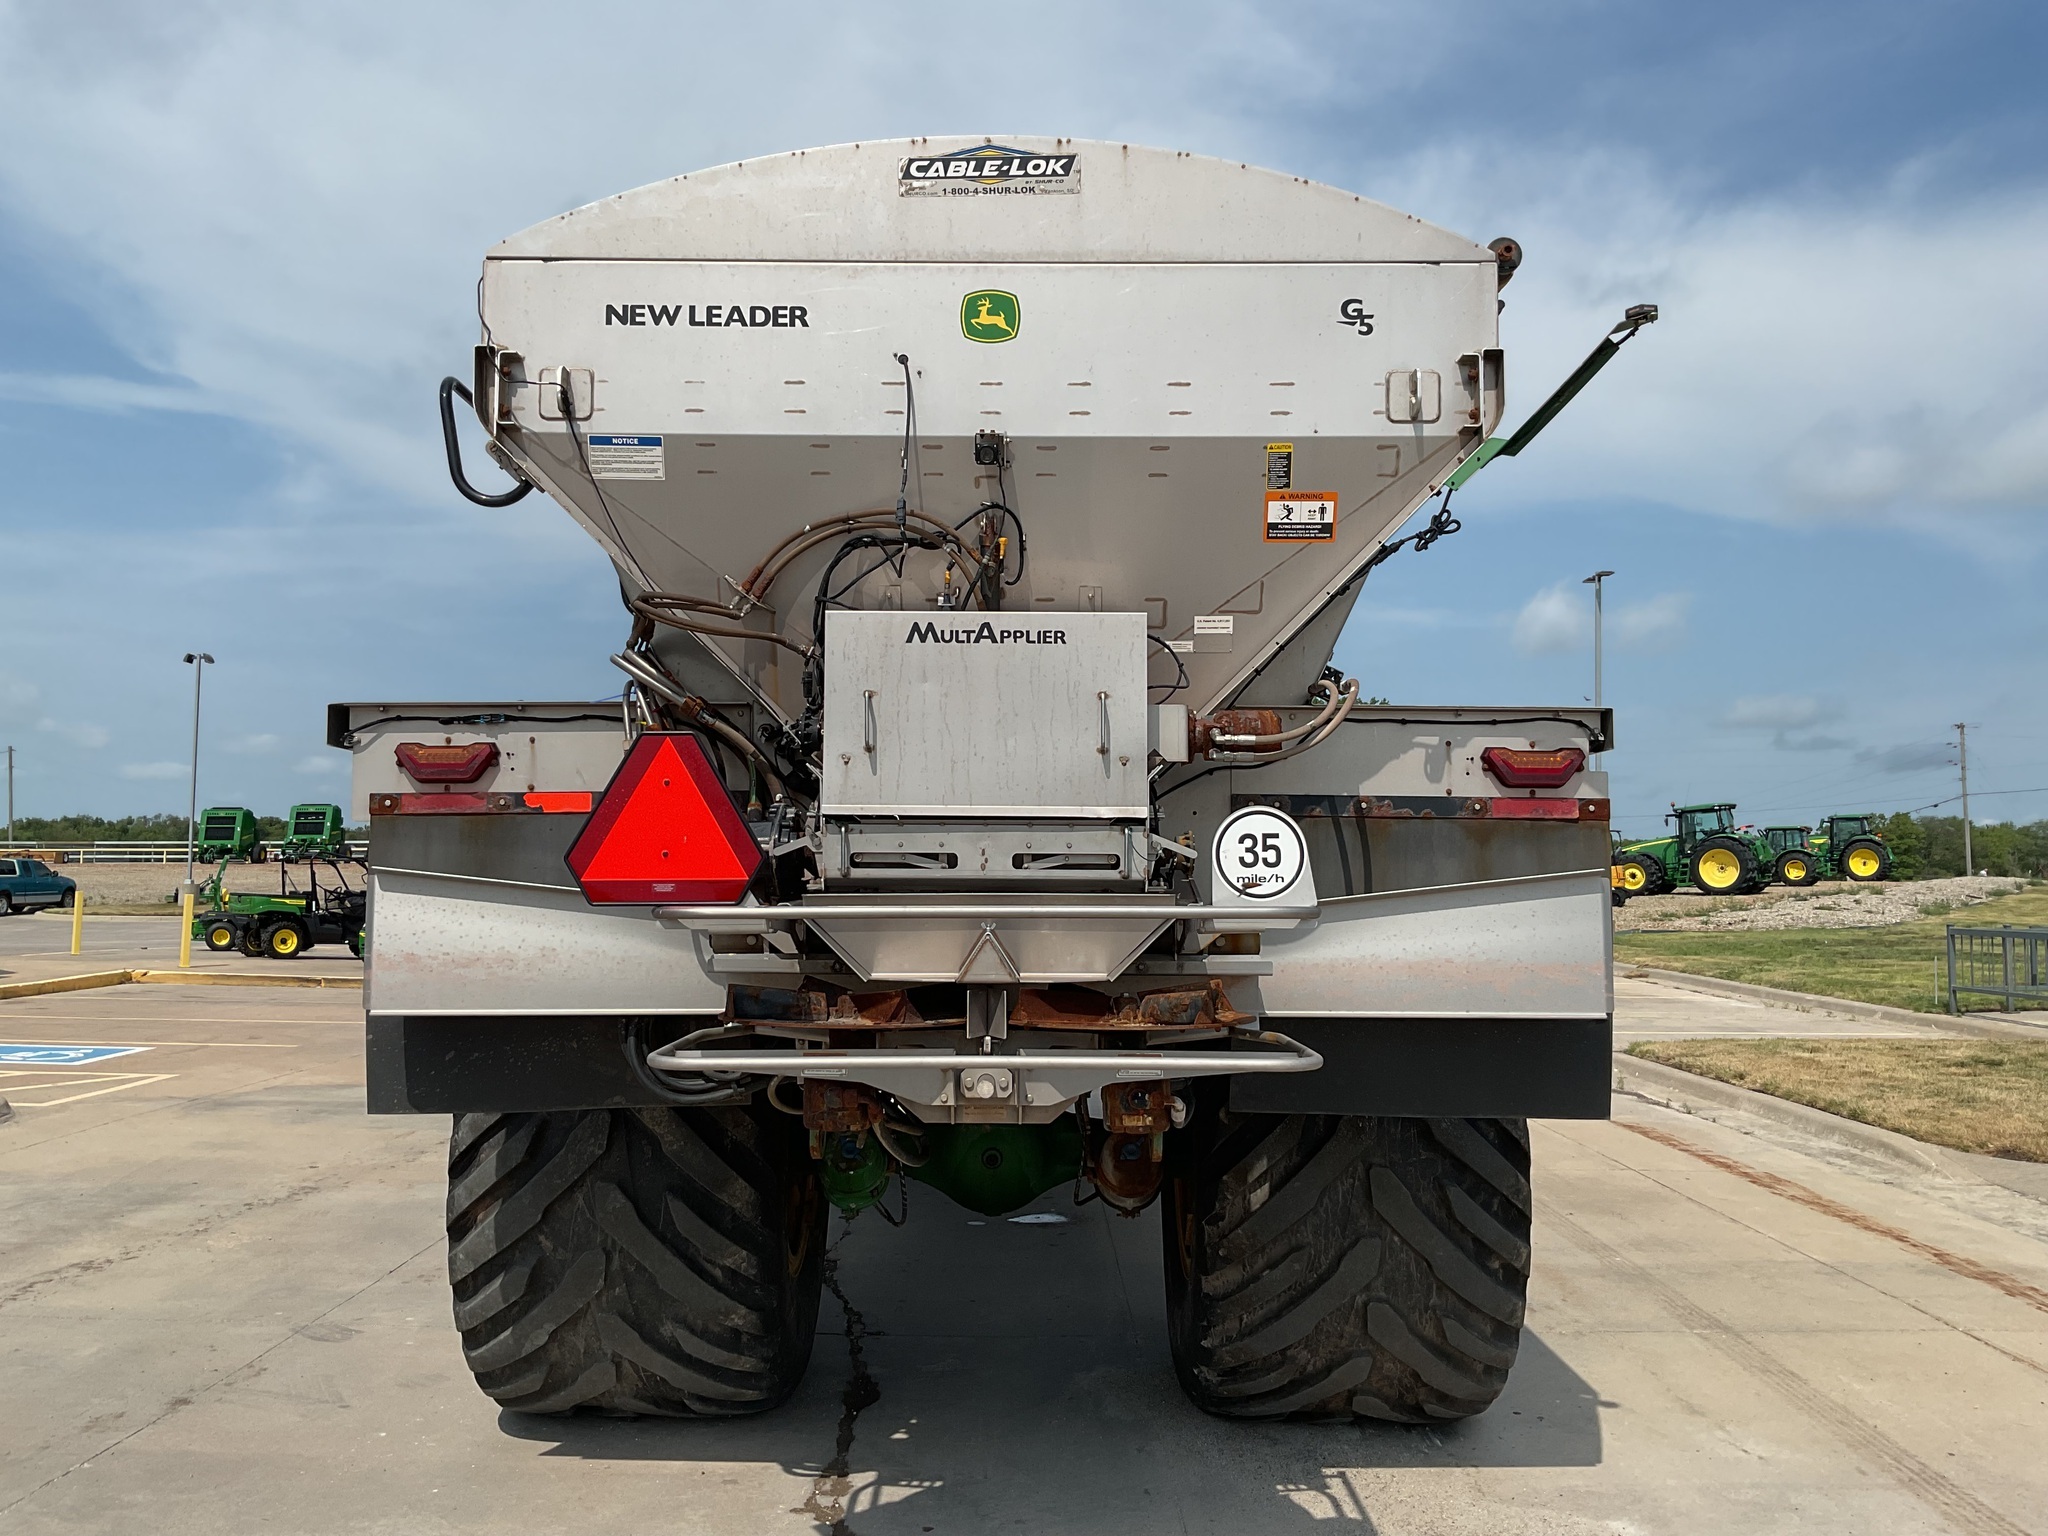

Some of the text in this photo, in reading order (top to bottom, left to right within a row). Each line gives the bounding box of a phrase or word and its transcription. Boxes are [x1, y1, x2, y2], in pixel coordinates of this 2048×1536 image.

[909, 158, 1069, 178] CABLE-LOK
[942, 186, 1036, 195] 1-800-4-SHUR-LOK
[605, 304, 810, 327] NEW LEADER
[1336, 298, 1374, 336] G5
[1238, 832, 1281, 868] 35
[1236, 873, 1285, 883] mile/h
